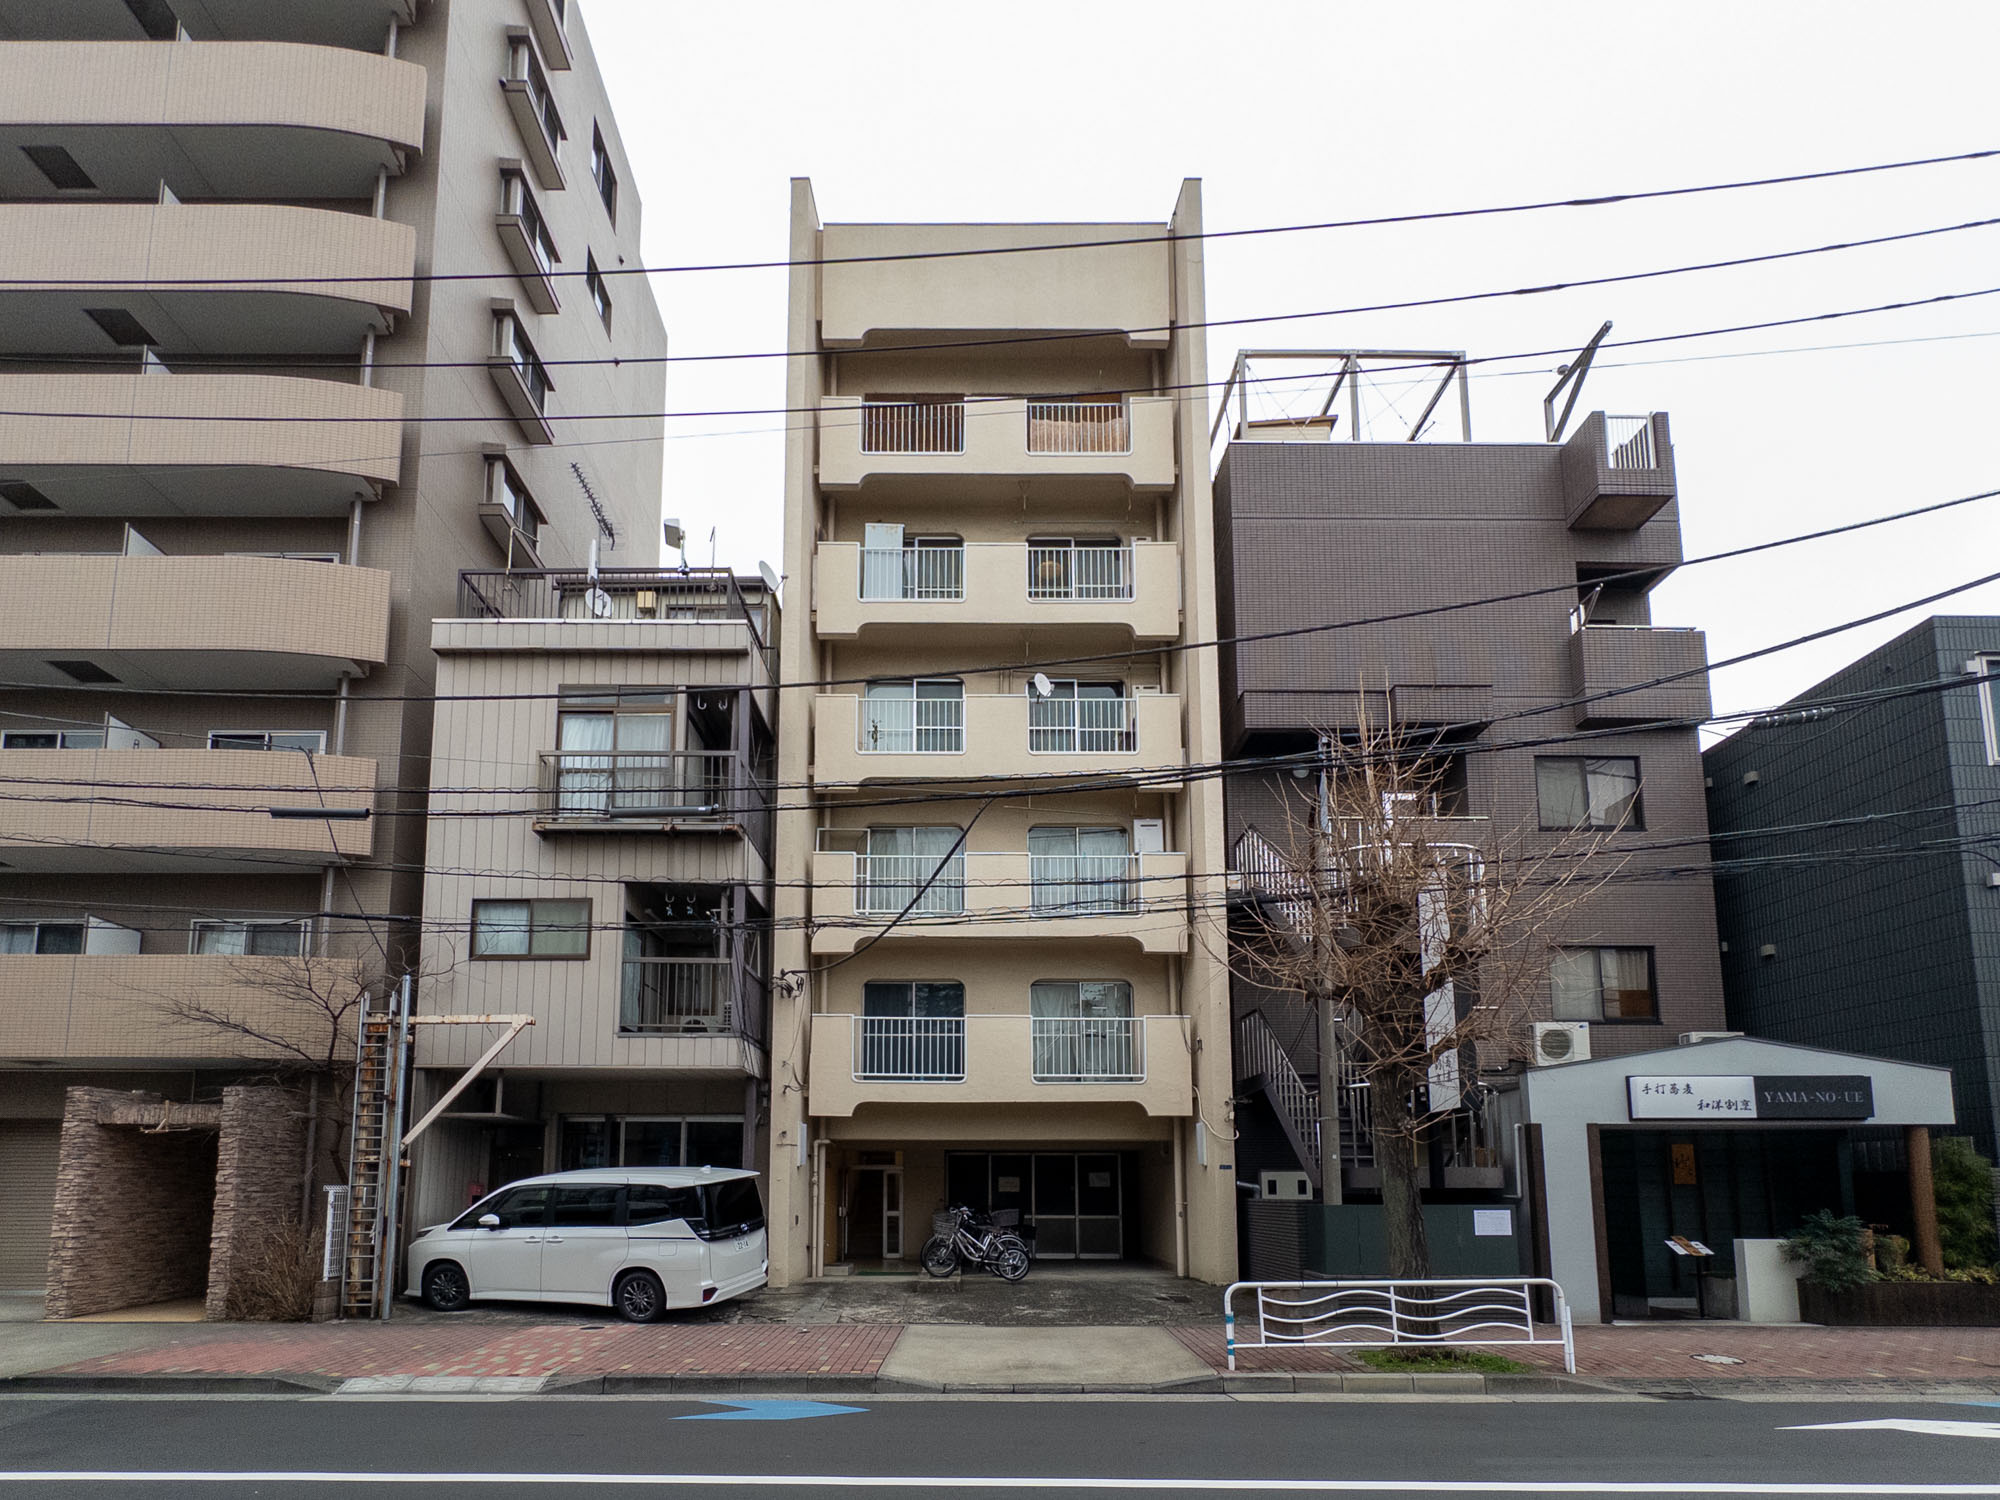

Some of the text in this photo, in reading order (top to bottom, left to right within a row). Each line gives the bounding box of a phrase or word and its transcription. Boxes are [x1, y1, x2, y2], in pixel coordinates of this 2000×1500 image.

[1642, 1083, 1694, 1095] 手打蕎麦
[1764, 1091, 1864, 1103] YAMA-NO-UE
[1697, 1099, 1752, 1111] 和洋割烹
